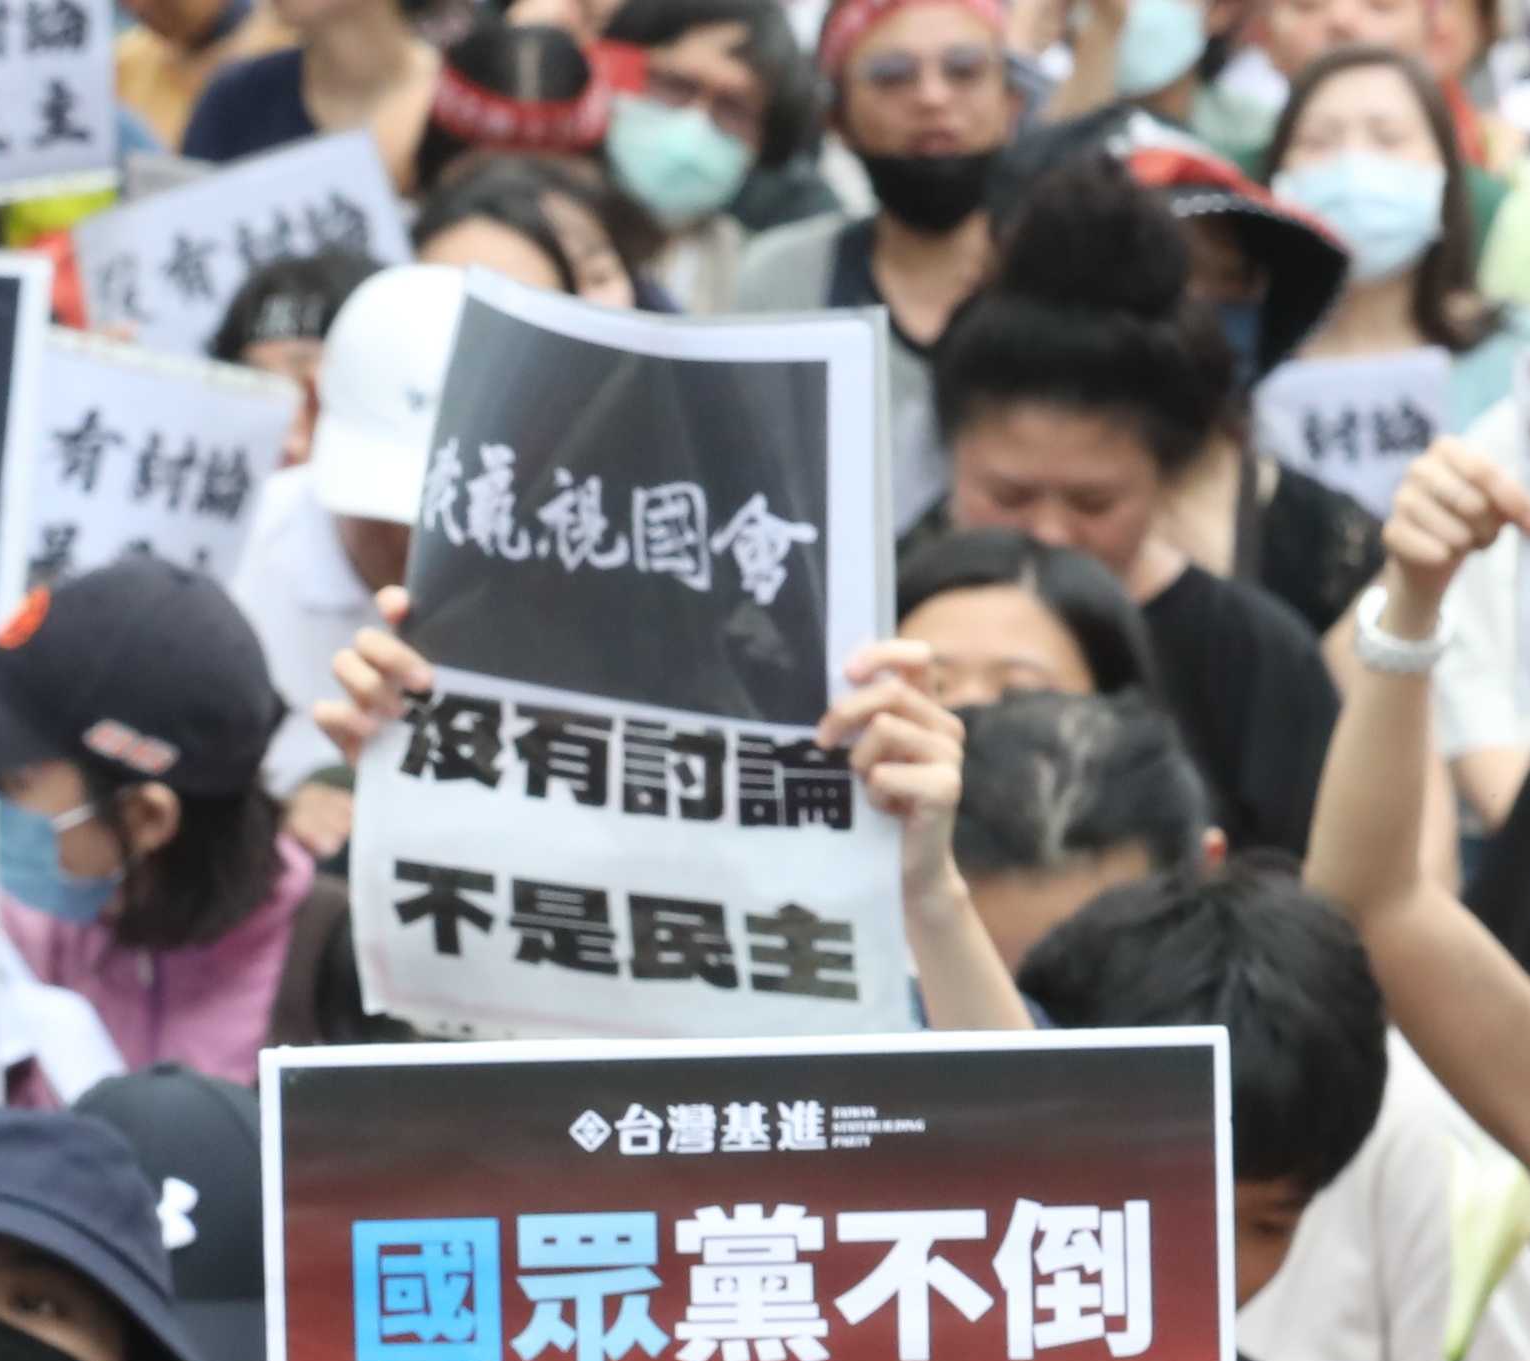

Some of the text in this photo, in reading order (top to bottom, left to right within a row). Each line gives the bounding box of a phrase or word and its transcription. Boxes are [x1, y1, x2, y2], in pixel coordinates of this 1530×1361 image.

[423, 437, 818, 606] 我藐視國會
[399, 688, 854, 831] 沒有討論
[393, 858, 860, 1002] 不是民主
[614, 1101, 828, 1156] 台灣基進
